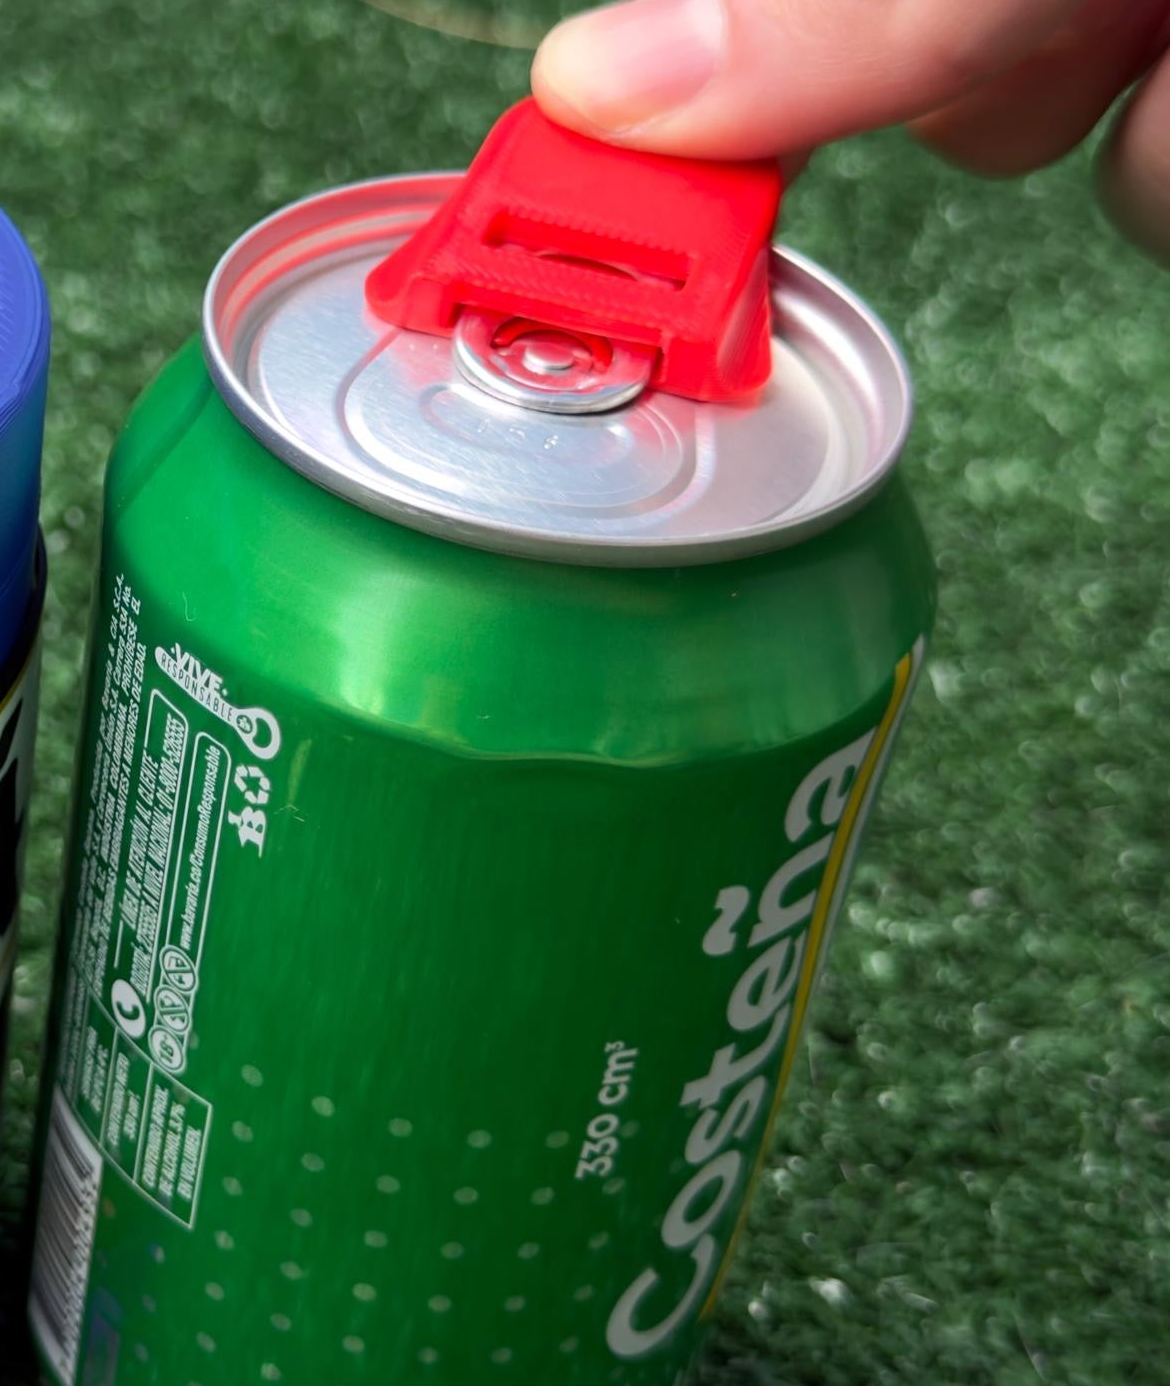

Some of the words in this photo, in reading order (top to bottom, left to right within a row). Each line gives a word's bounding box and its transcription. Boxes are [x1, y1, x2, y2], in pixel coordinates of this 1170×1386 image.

[131, 596, 140, 616] EL
[113, 635, 125, 686] Carrera
[131, 677, 141, 702] DE
[134, 643, 146, 682] EDAD.
[160, 653, 233, 721] RESPONSABLE
[124, 700, 138, 766] MENORES
[136, 749, 159, 806] CLIENTE
[134, 799, 151, 824] AL
[146, 803, 171, 869] NACIONAL:
[126, 812, 149, 880] ATENCIÓN
[180, 745, 221, 949] www.bavaria.co/ConsumoResponsable
[606, 726, 876, 1359] Costeña
[141, 1121, 162, 1188] CONTENIDO
[161, 1127, 181, 1182] ALCOHOL
[576, 1113, 620, 1181] 330
